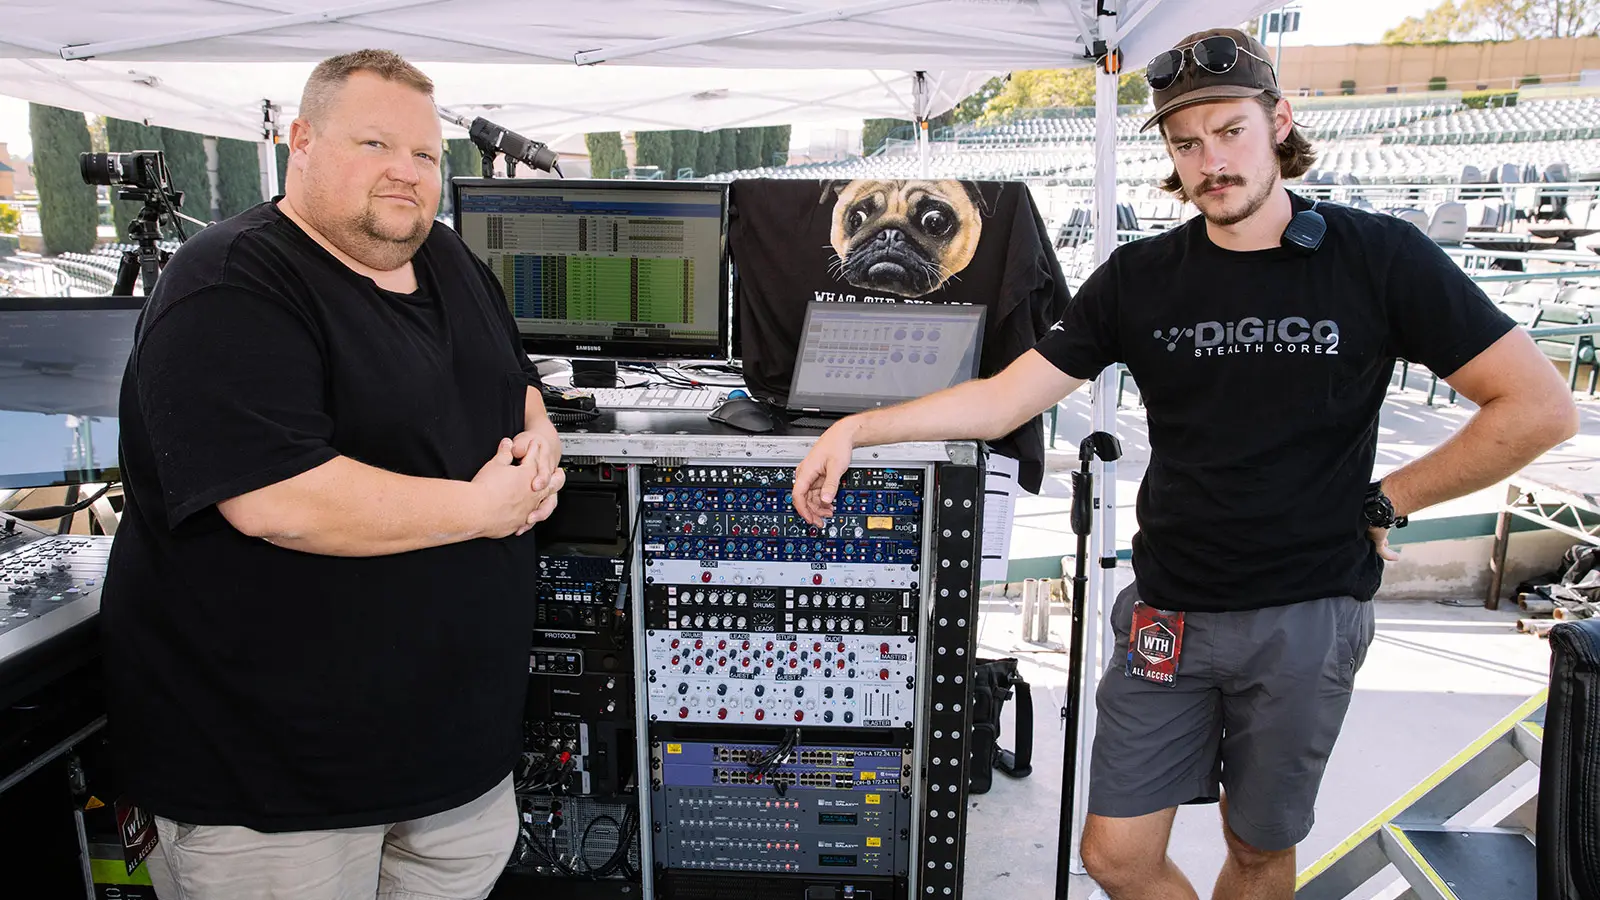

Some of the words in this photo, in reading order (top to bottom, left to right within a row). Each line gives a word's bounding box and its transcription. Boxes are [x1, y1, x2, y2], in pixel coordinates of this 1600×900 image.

[1195, 316, 1339, 348] DiGiCo
[1195, 343, 1263, 357] STEALTH
[1144, 635, 1169, 652] WTH
[1132, 667, 1144, 677] ALL
[1146, 670, 1173, 682] ACCESS
[128, 859, 138, 872] ALL
[139, 836, 157, 858] ACCESS
